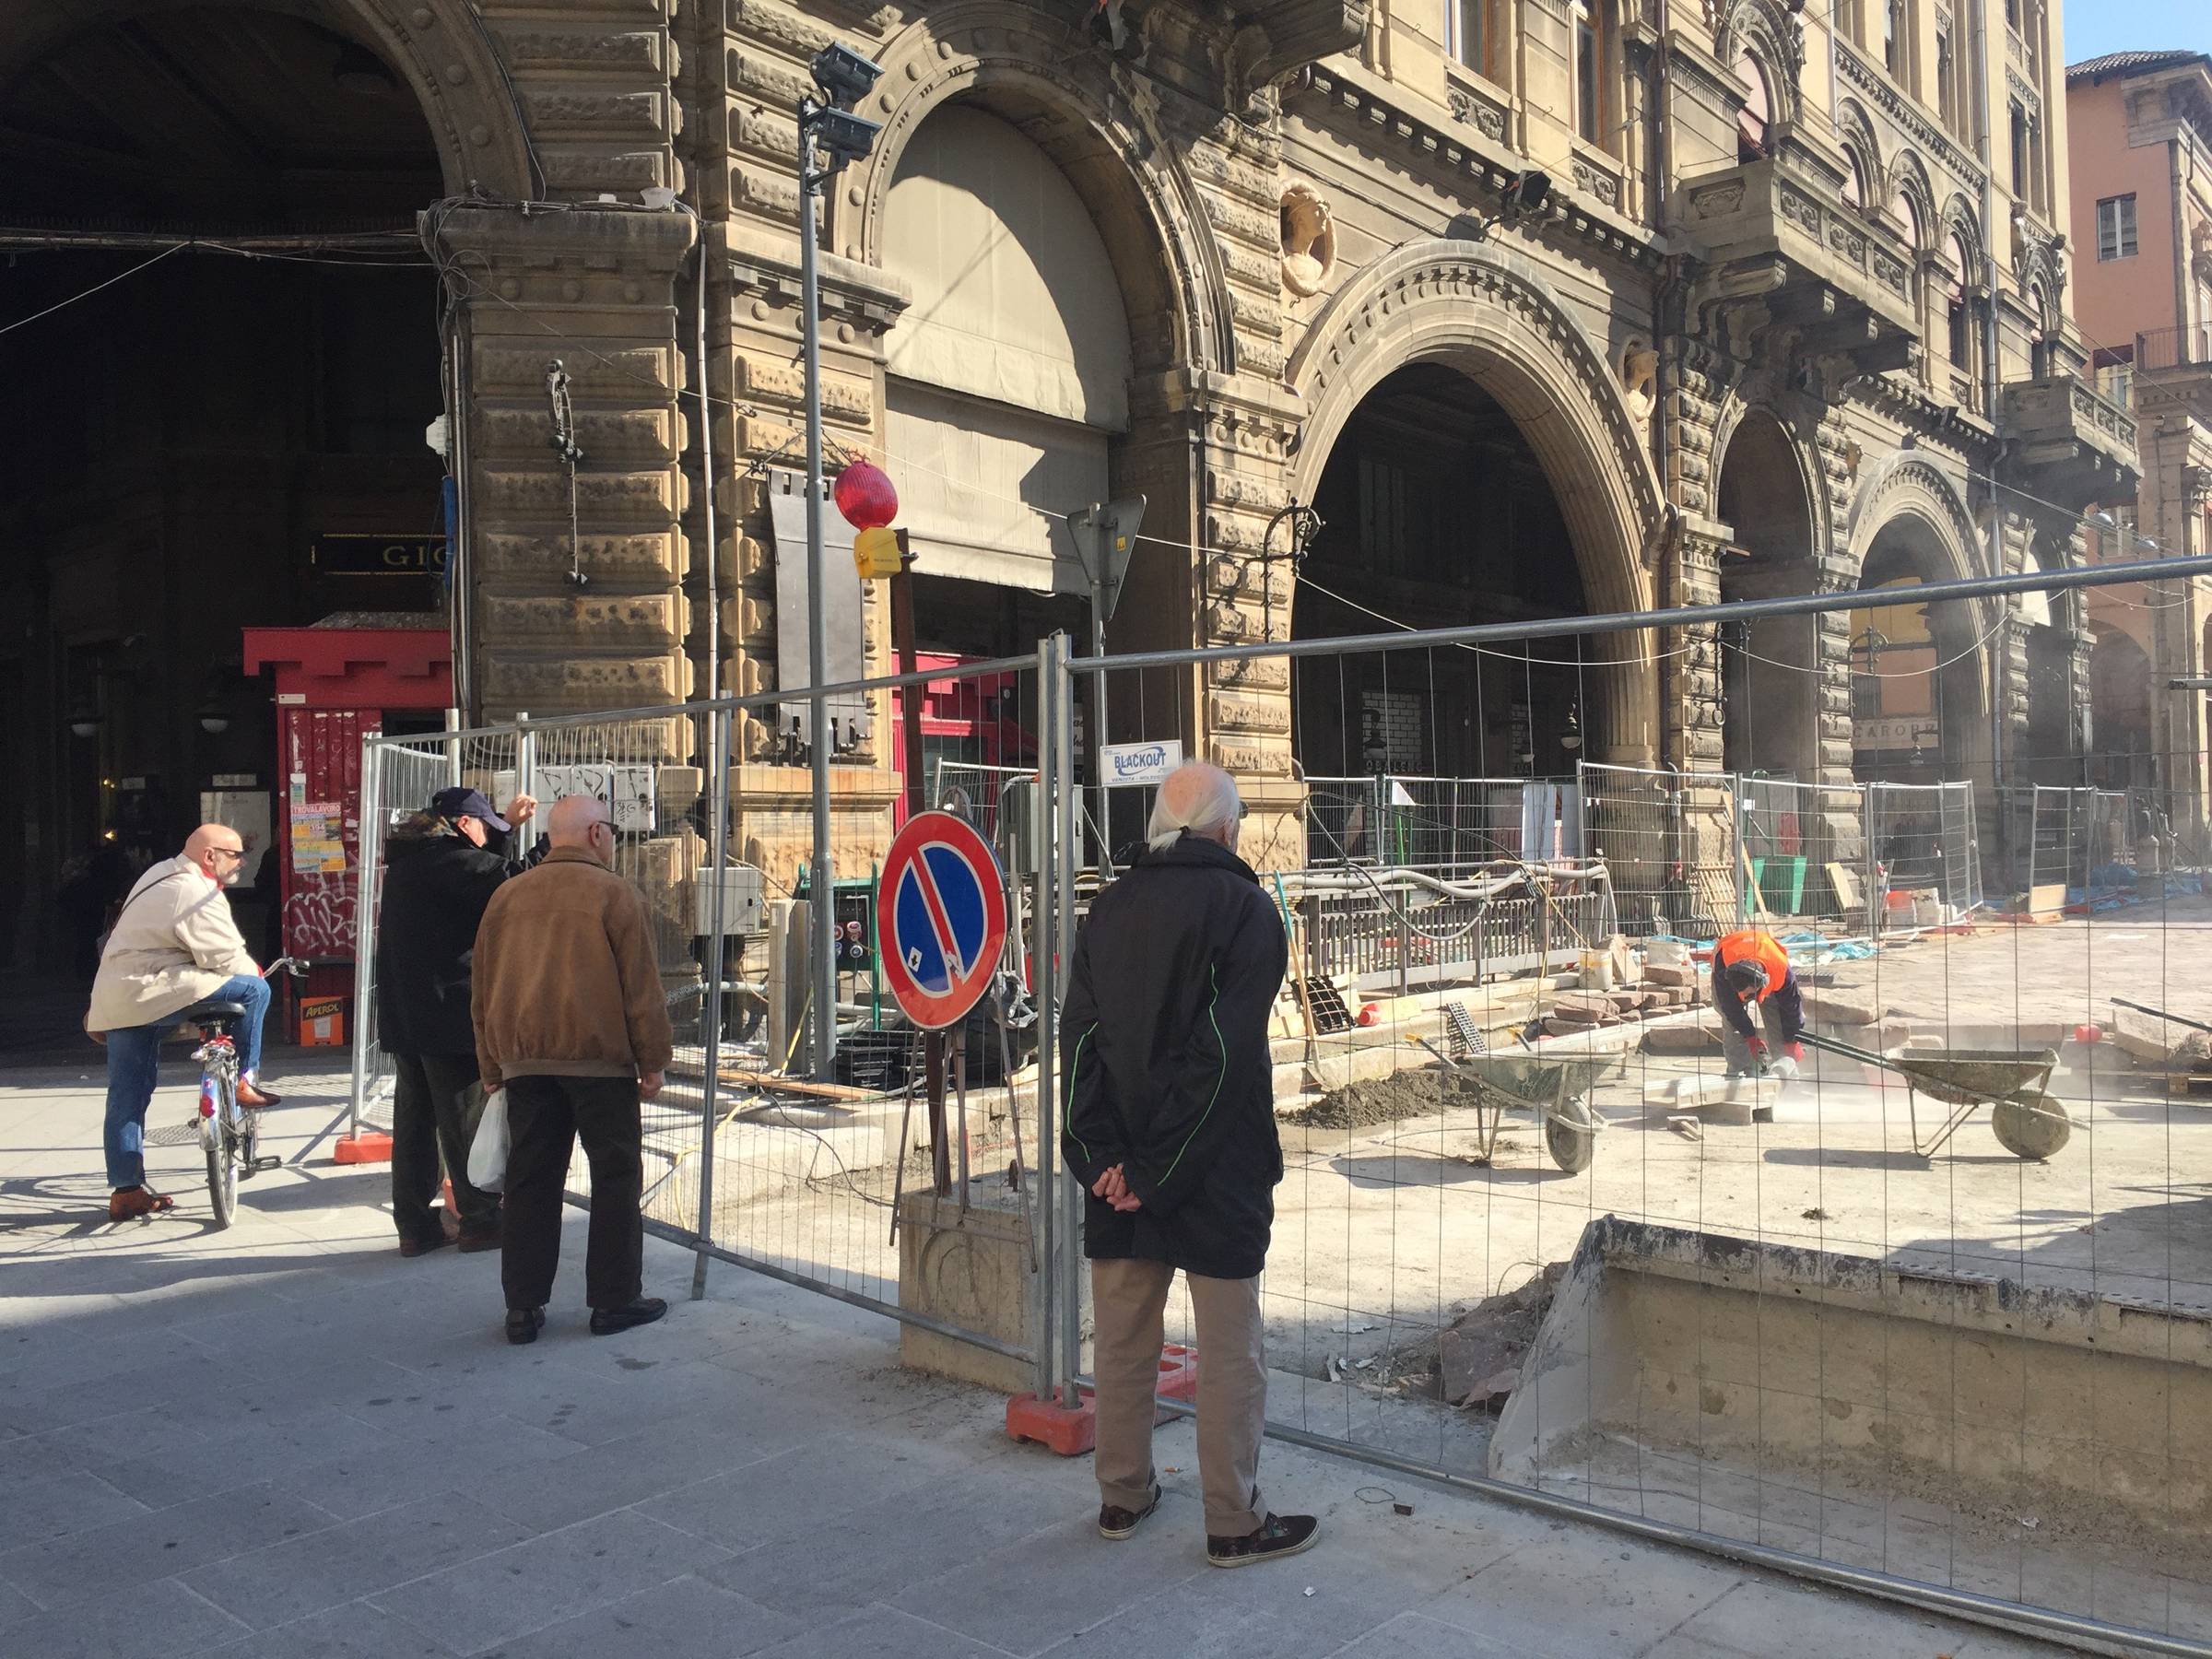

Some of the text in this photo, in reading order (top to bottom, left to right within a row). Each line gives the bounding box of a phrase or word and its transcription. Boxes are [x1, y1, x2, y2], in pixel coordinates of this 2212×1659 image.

[1114, 752, 1167, 769] BLACKOUT
[292, 804, 341, 815] TROVALAVORO
[306, 1003, 339, 1018] APEROL
